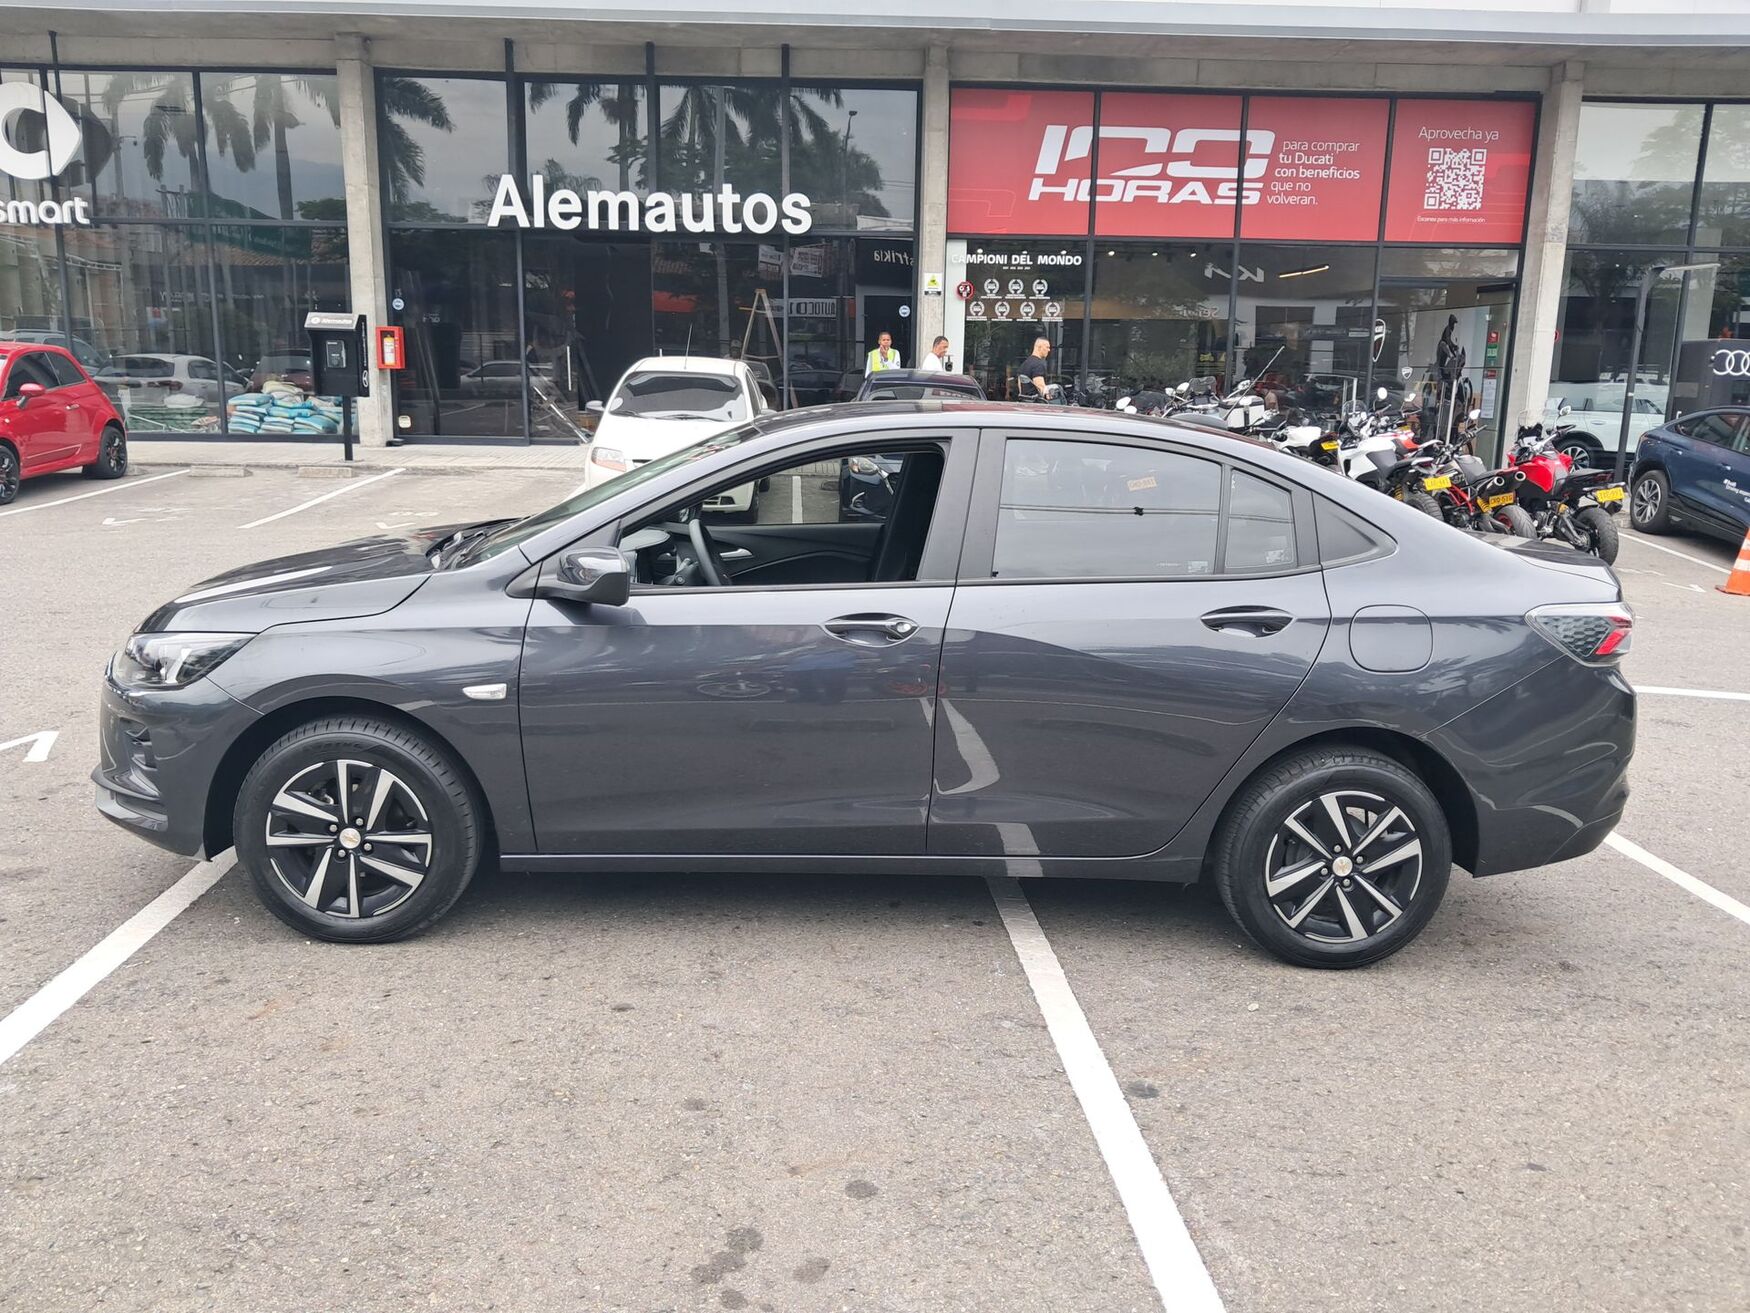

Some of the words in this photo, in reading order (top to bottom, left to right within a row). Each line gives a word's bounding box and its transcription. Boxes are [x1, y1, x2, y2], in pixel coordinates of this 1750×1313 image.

[1418, 126, 1482, 141] Aprovecha
[1485, 130, 1499, 144] ya
[1283, 141, 1308, 152] para
[1311, 141, 1360, 154] comprar
[1279, 152, 1291, 164] tu
[1295, 152, 1334, 165] Ducati
[1274, 167, 1296, 178] con
[1299, 165, 1360, 179] beneficios
[1028, 178, 1264, 205] HORAS
[1270, 181, 1293, 193] que
[1296, 182, 1311, 191] no
[487, 174, 813, 234] Alemautos
[951, 254, 1008, 265] CAMPIONI
[1011, 254, 1033, 265] DEL
[1037, 255, 1082, 266] MONDO
